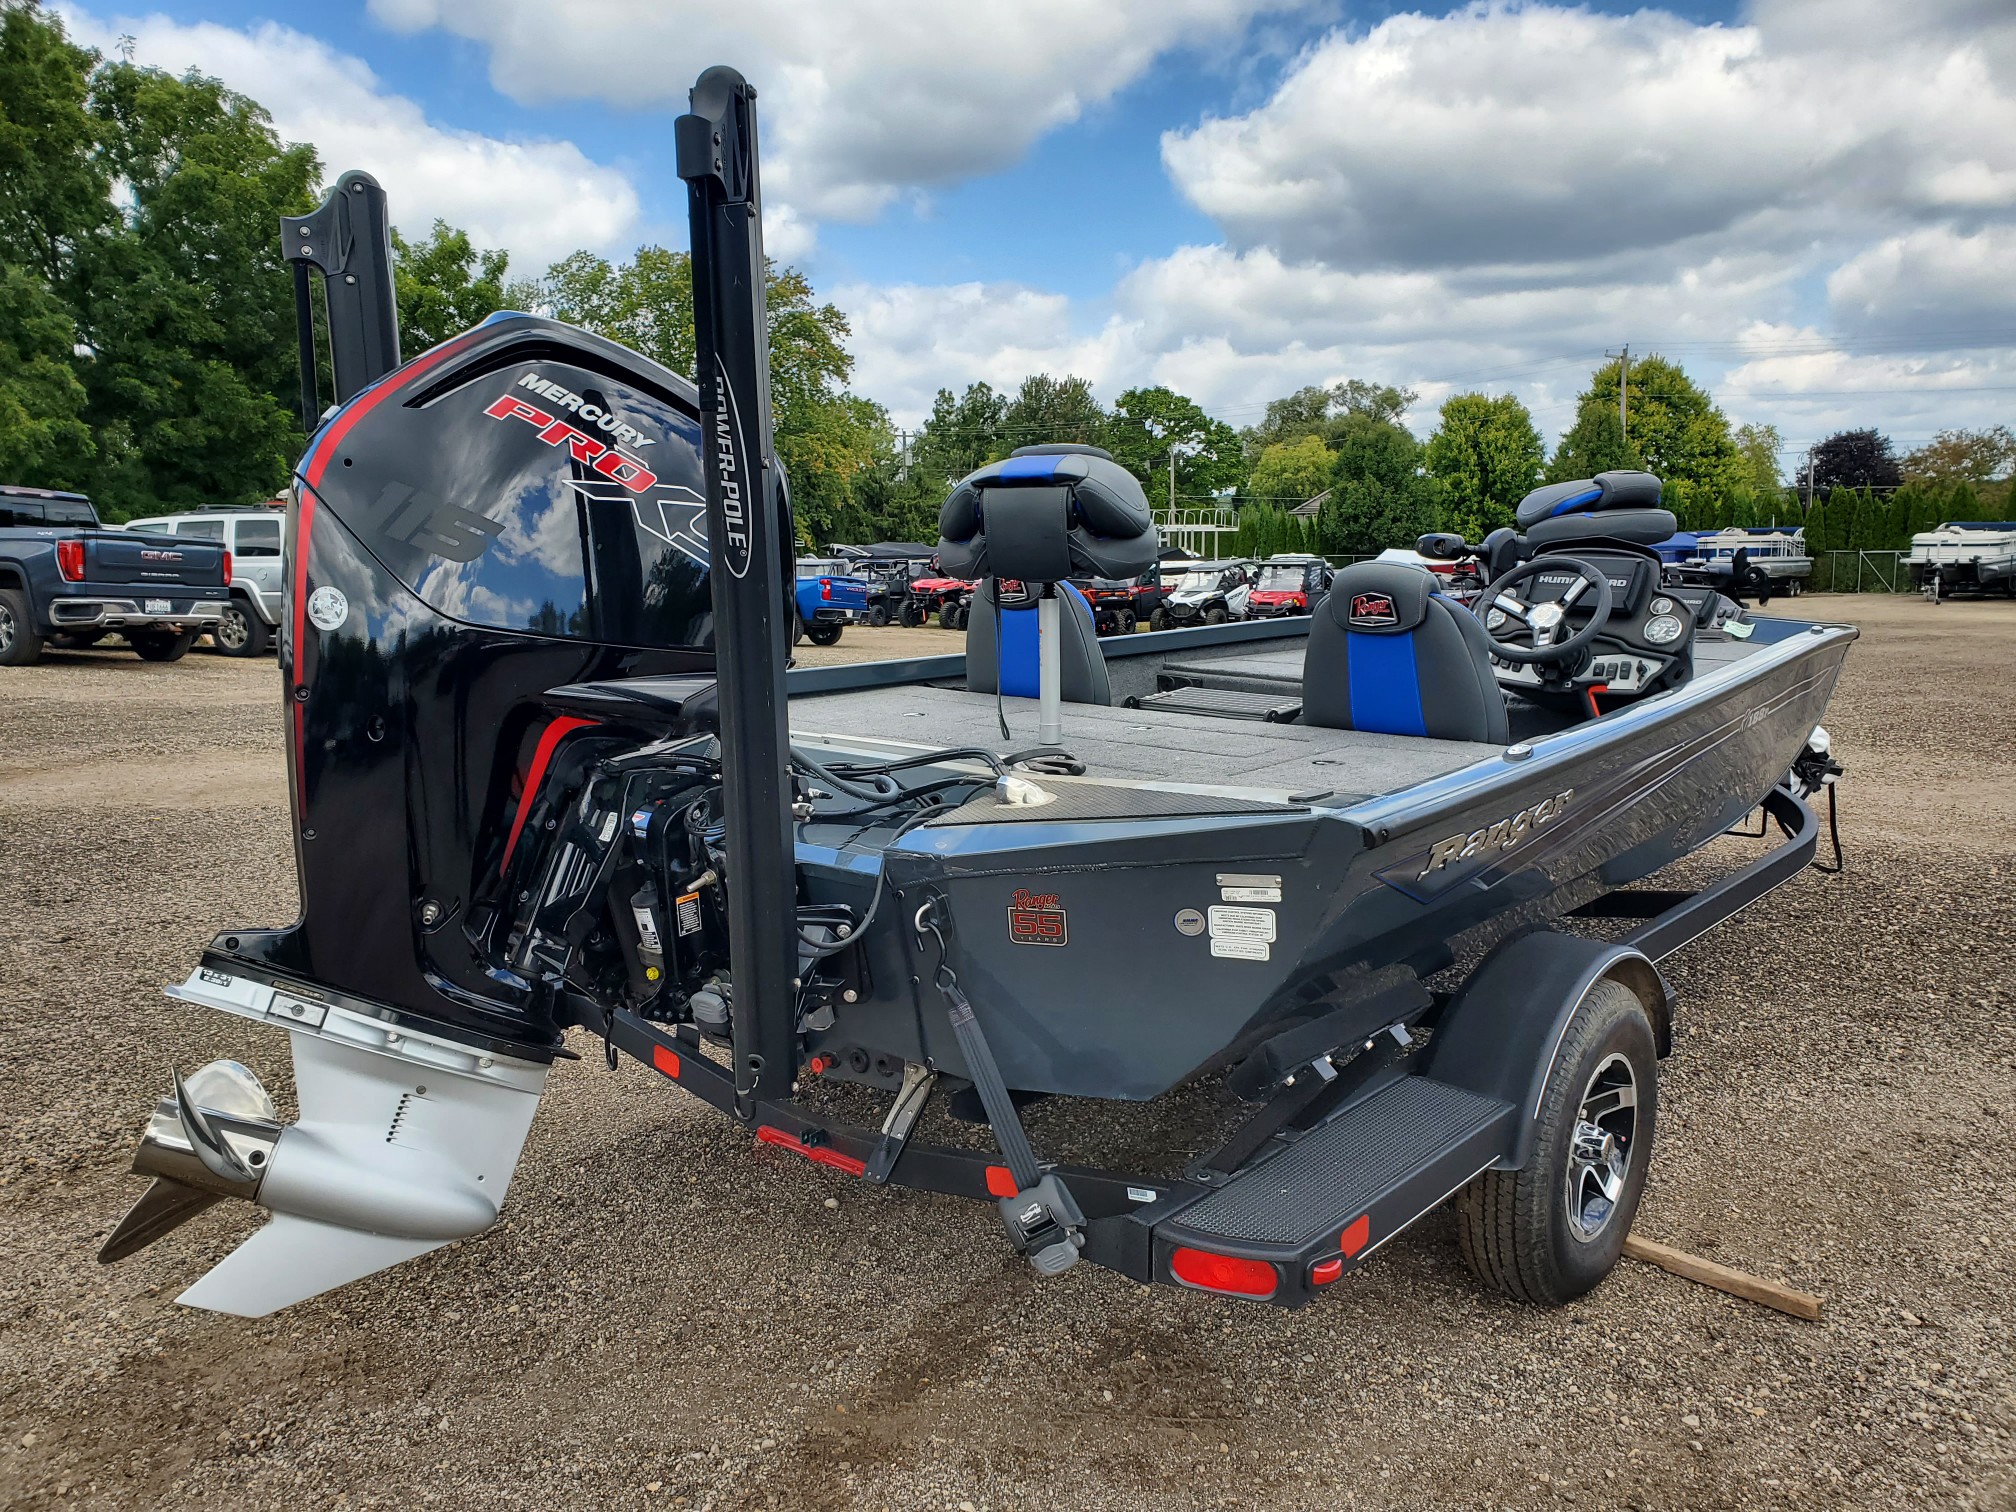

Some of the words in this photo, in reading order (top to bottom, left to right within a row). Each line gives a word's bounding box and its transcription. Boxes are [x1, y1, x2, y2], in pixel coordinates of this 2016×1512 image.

[517, 372, 657, 449] MERCURY
[482, 393, 658, 494] PRO
[368, 480, 507, 564] 115
[140, 550, 183, 561] GMC
[1353, 596, 1389, 617] Ranger
[1416, 788, 1575, 883] Ranger
[1011, 888, 1060, 911] Ranger
[1012, 912, 1063, 937] 55
